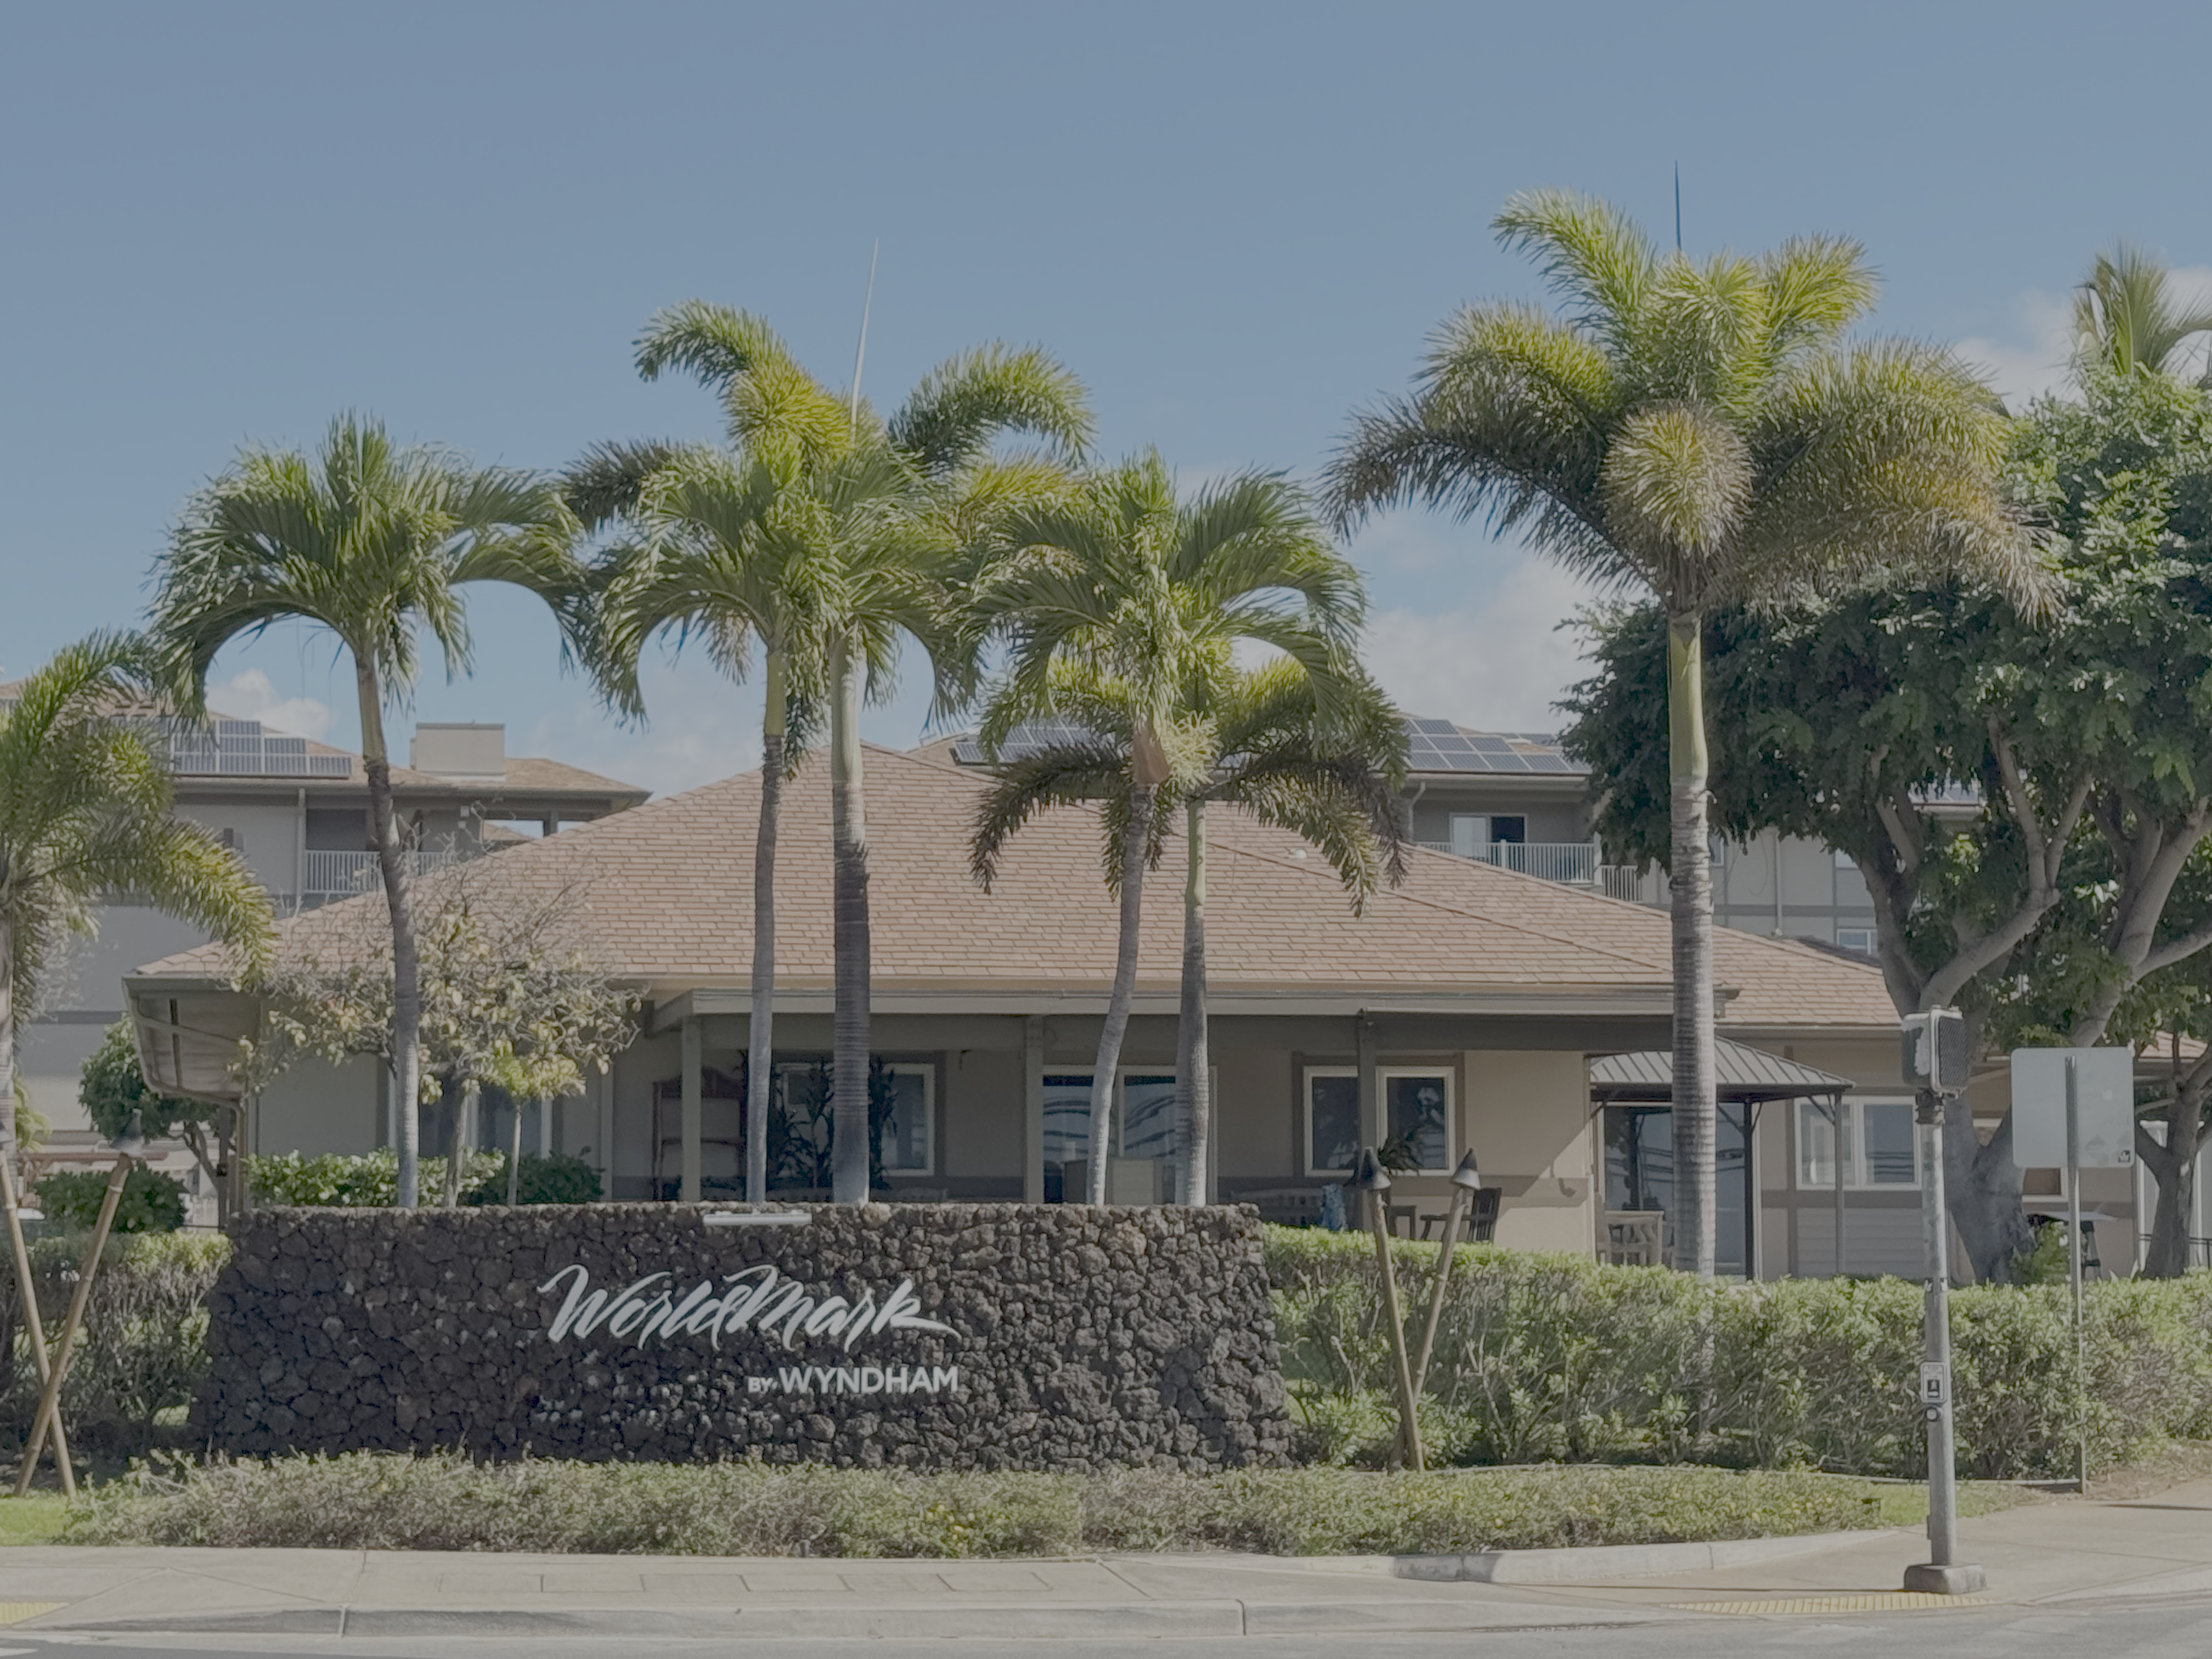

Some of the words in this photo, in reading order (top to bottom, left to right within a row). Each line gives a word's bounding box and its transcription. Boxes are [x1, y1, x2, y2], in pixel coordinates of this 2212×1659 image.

[537, 1264, 962, 1353] WorldMark
[748, 1376, 773, 1393] BY
[778, 1366, 958, 1394] WYNDHAM
